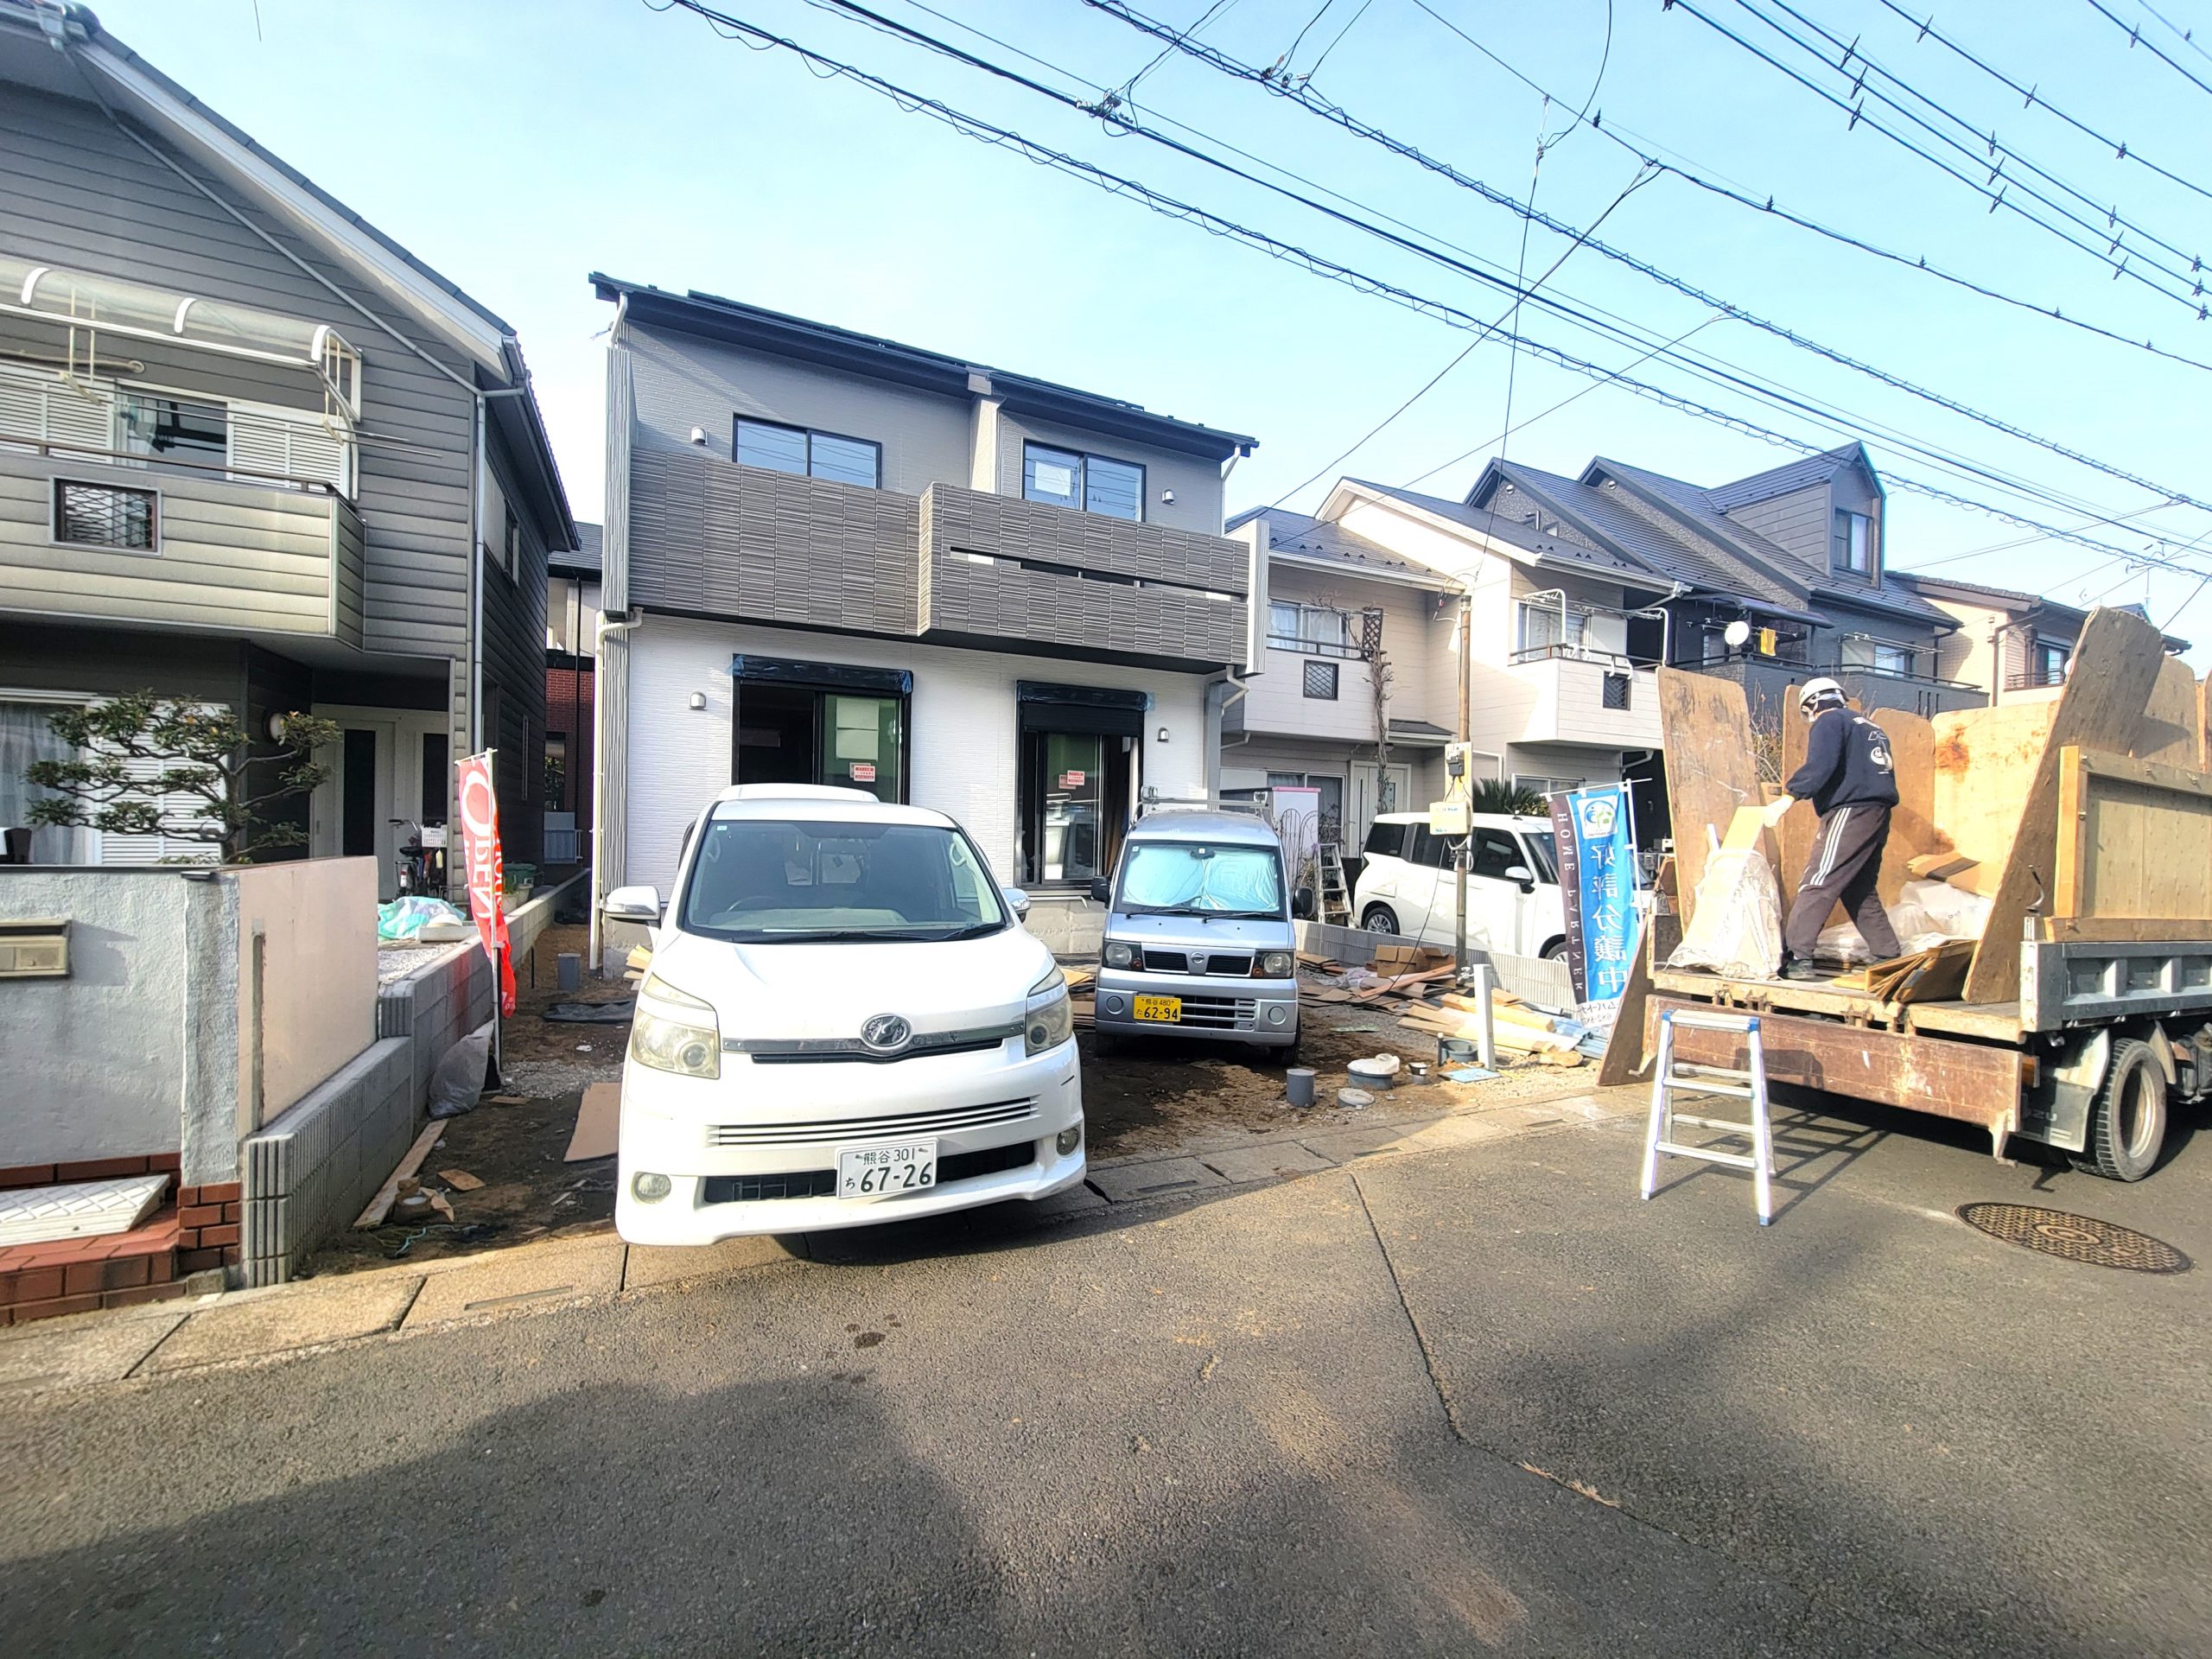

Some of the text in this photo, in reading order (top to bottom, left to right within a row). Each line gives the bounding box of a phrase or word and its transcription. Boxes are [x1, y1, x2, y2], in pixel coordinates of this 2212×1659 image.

[1144, 1007, 1178, 1020] 62-94
[863, 1147, 915, 1166] 熊谷 301
[845, 1161, 932, 1192] ち 67-26
